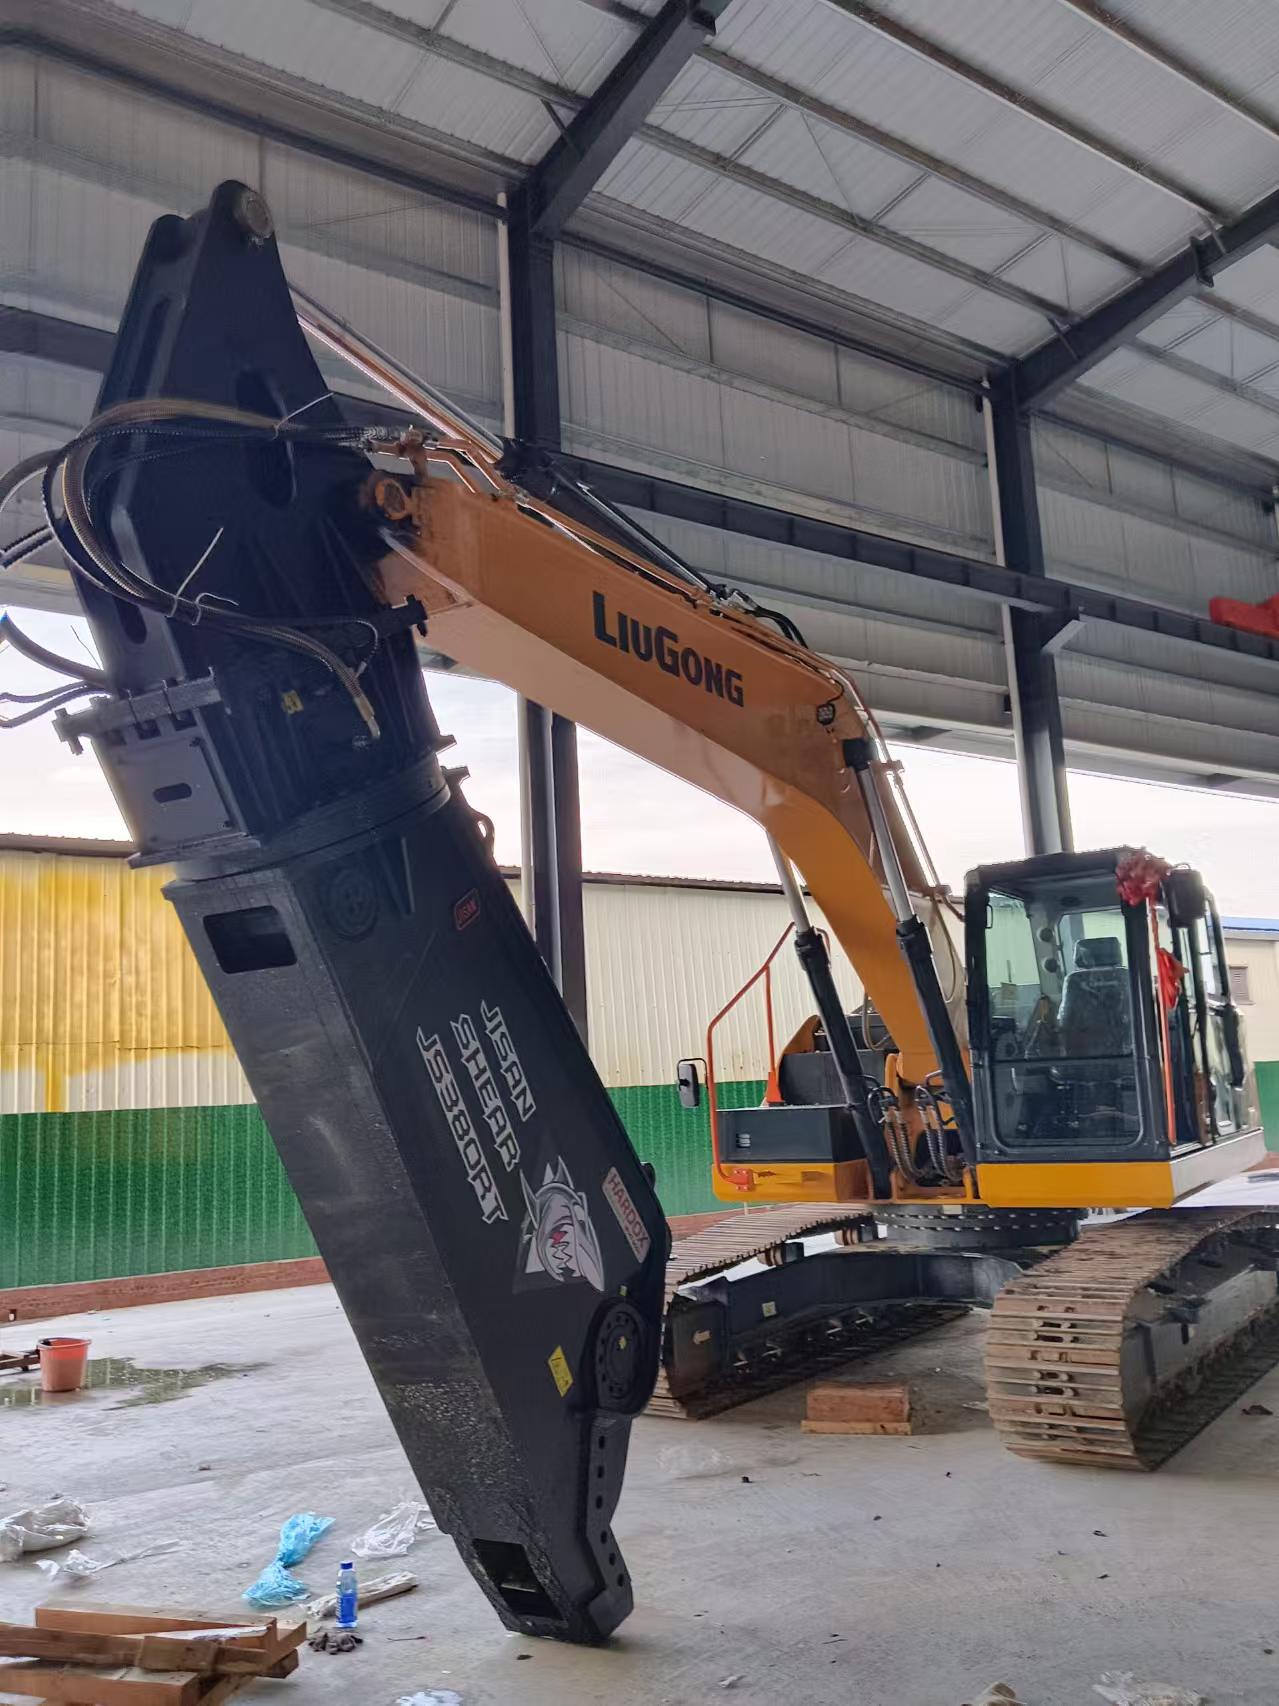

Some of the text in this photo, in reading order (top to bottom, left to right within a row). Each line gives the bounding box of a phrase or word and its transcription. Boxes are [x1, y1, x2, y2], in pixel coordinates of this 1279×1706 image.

[416, 1026, 509, 1224] JS380RT
[450, 1014, 521, 1172] SHEAR
[480, 1000, 536, 1122] JISAN
[607, 1173, 649, 1248] HARDOX
